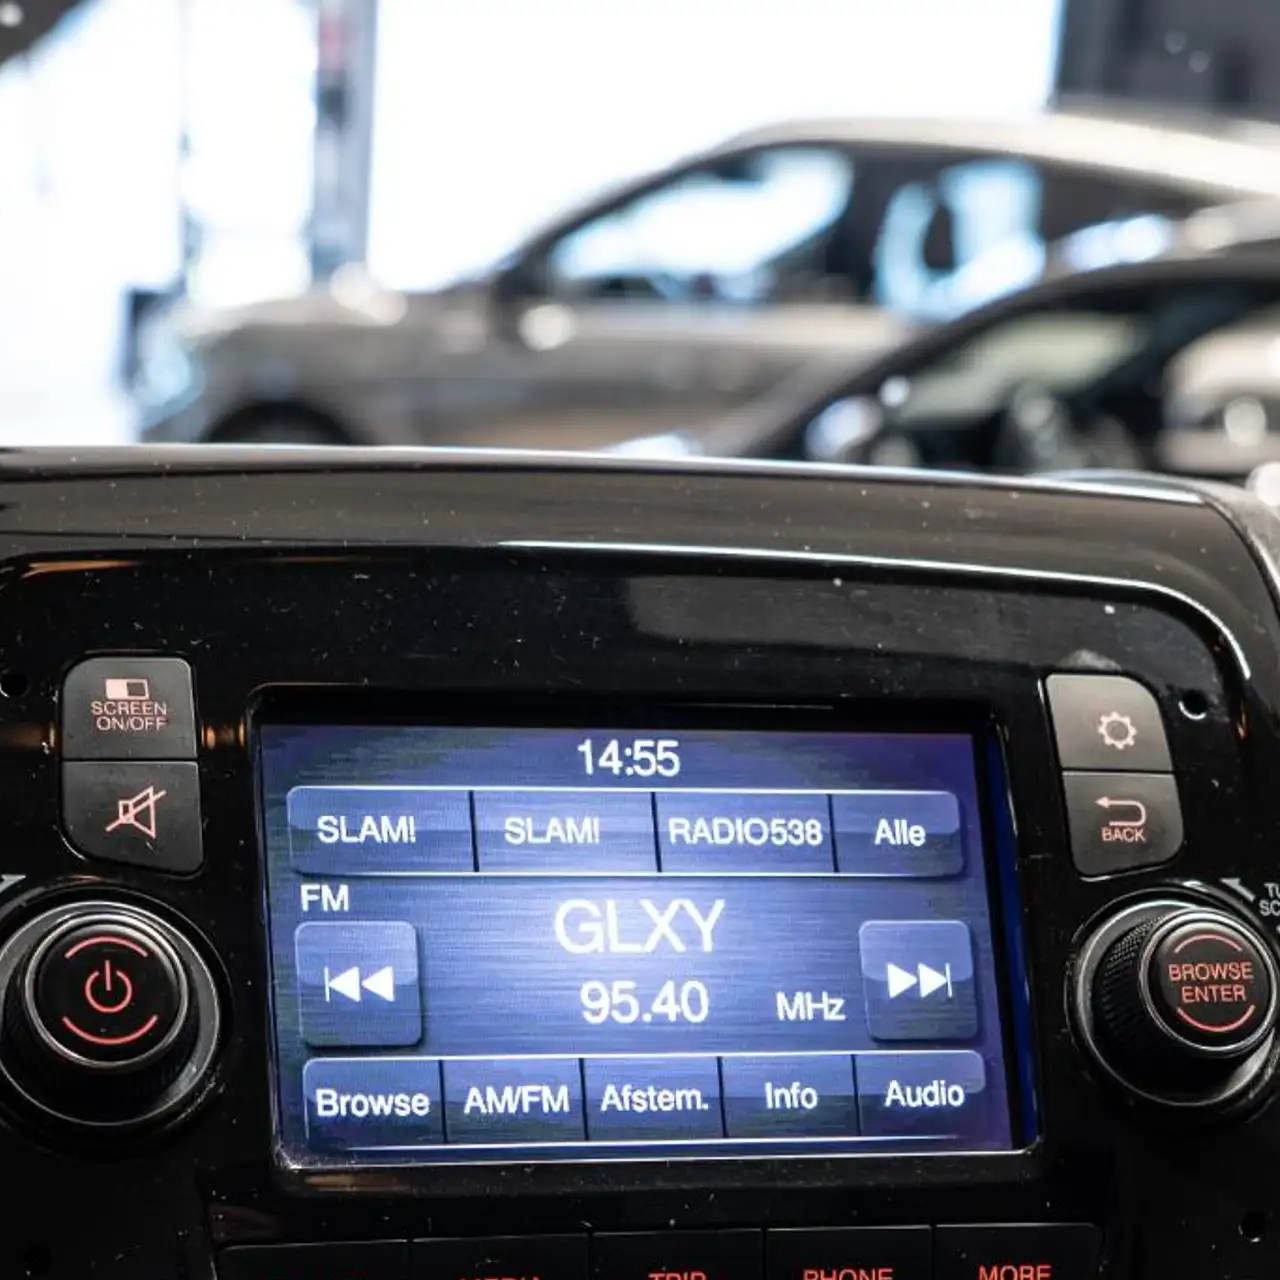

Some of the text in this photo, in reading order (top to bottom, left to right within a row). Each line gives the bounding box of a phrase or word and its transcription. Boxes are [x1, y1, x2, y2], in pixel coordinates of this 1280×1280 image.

[91, 700, 168, 717] SCREEN
[96, 715, 167, 732] ON/OFF
[577, 738, 681, 777] 14:55
[317, 814, 417, 844] SLAM!
[503, 815, 601, 845] SLAM!
[667, 817, 823, 847] RADIO538
[874, 817, 926, 847] Alle
[1101, 825, 1146, 843] BACK
[300, 883, 350, 912] FM
[552, 898, 725, 955] GLXY
[1168, 961, 1254, 982] BROWSE
[579, 979, 846, 1024] 95.40 MHz
[1181, 984, 1247, 1003] ENTER
[315, 1087, 431, 1118] Browse
[463, 1083, 570, 1115] AM/FM
[600, 1083, 709, 1113] Afstem.
[764, 1080, 818, 1110] Info
[884, 1079, 965, 1108] Audio
